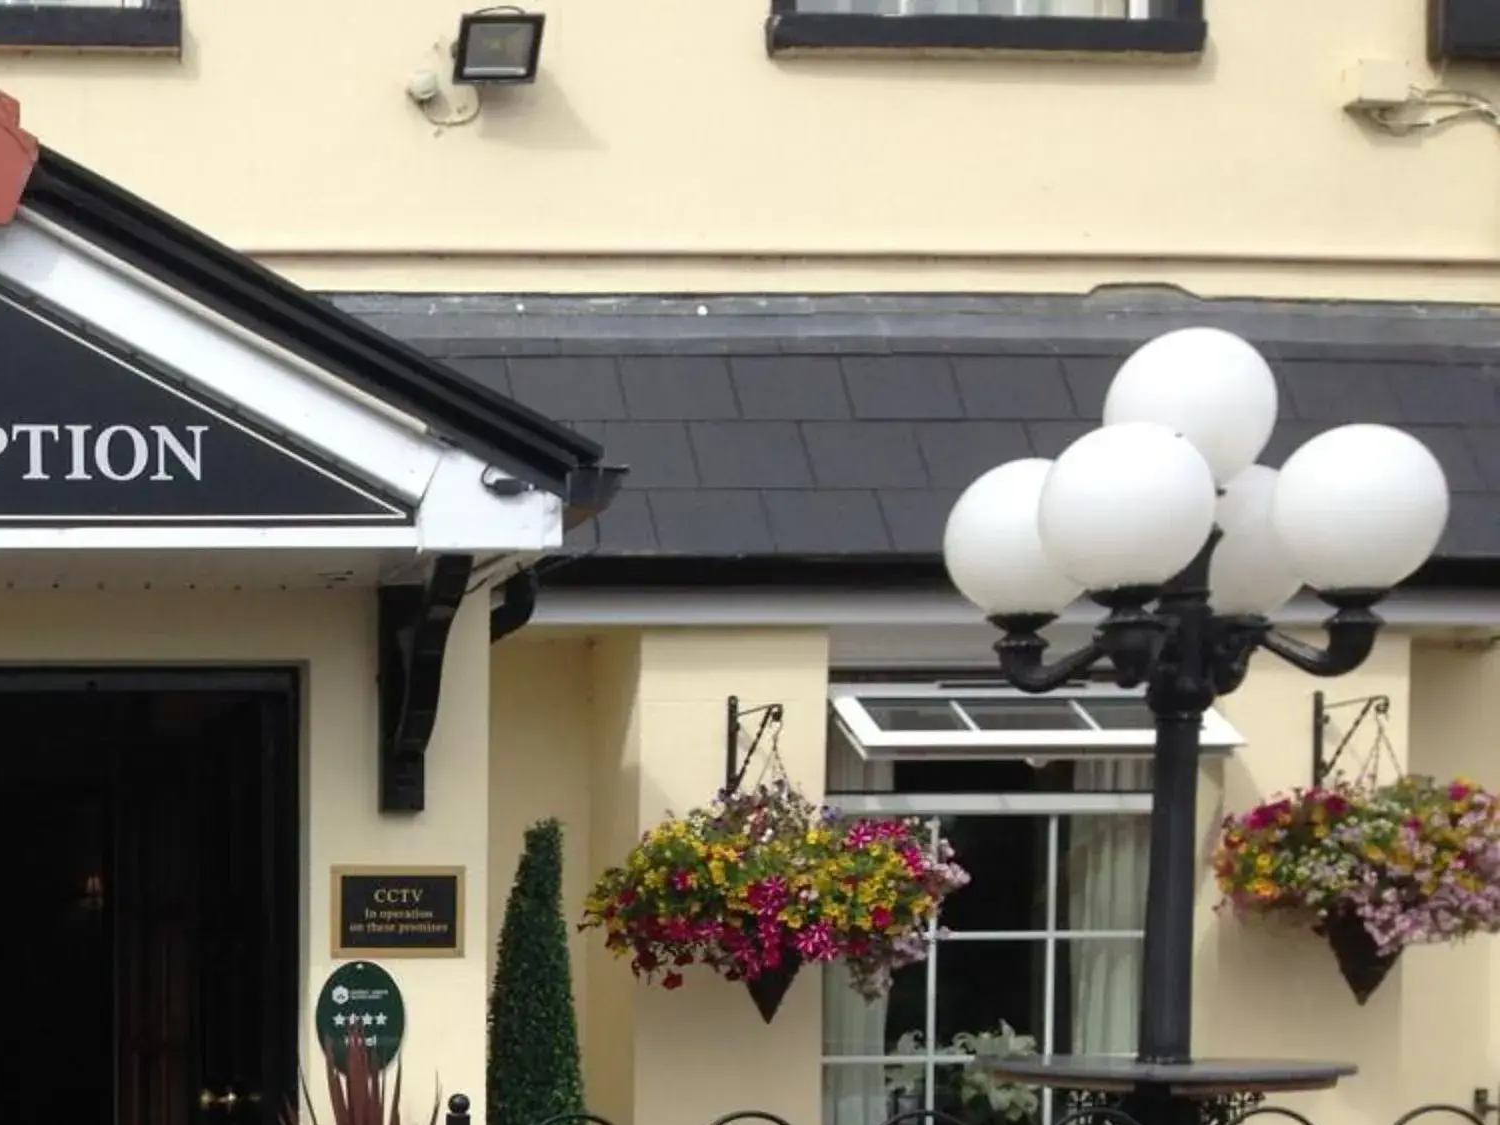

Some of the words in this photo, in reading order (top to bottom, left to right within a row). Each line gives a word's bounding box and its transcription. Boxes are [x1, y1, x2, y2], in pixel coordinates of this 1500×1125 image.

[374, 889, 424, 903] CCTV
[380, 908, 434, 922] operation
[367, 922, 396, 933] these
[398, 922, 448, 934] premises
